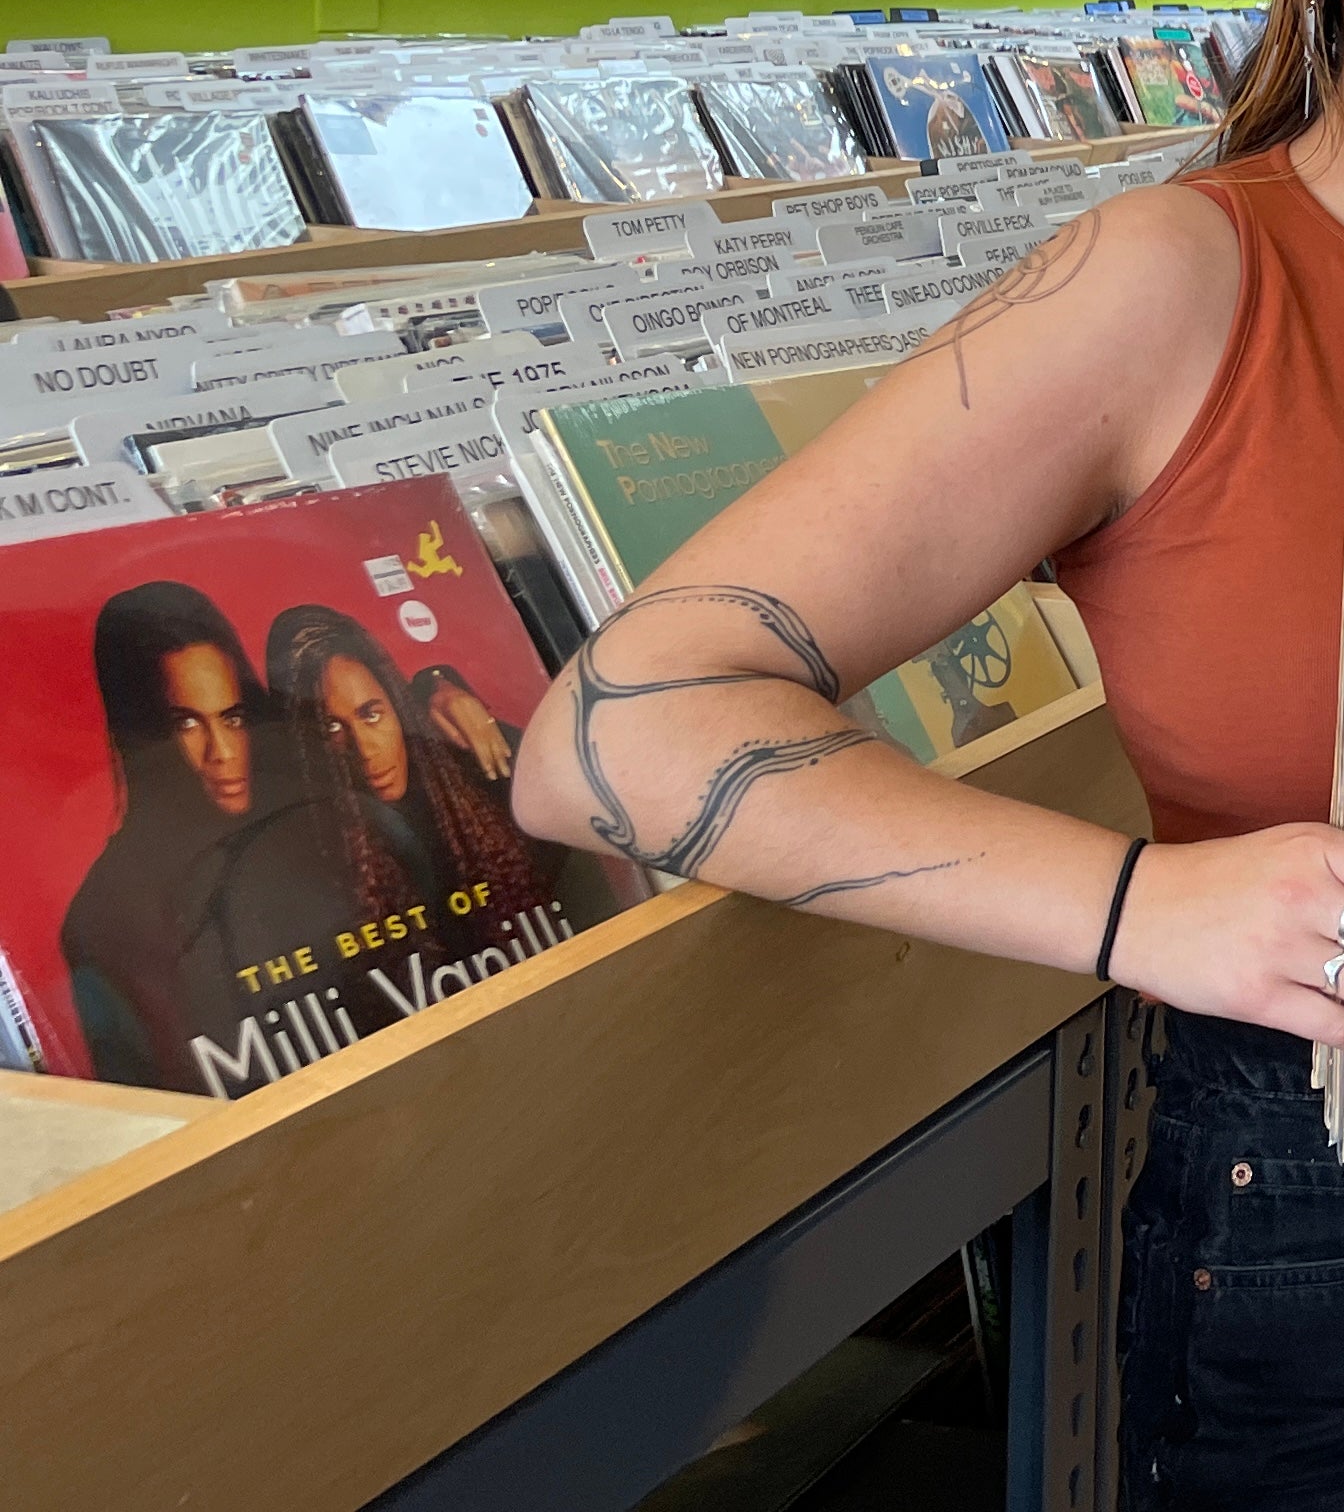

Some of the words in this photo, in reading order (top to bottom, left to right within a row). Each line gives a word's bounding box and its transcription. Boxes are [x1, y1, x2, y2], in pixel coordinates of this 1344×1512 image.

[813, 197, 845, 217] SHOP
[846, 192, 879, 210] BOYS
[612, 221, 644, 239] TOM
[644, 213, 687, 233] PETTY
[714, 236, 748, 255] KATY
[751, 230, 795, 251] PERRY
[956, 216, 1003, 238] ORVILLE
[1004, 214, 1035, 231] PECK
[715, 254, 780, 281] ORBISON
[890, 281, 941, 309] SINEAD
[632, 306, 686, 333] OINGO
[727, 313, 749, 335] OF
[751, 295, 833, 330] MONTREAL
[731, 352, 767, 371] NEW
[769, 334, 894, 367] PORNOGRAPHERS
[33, 369, 75, 394] NO
[76, 358, 160, 389] DOUBT
[374, 445, 460, 483] STEVIE
[596, 439, 651, 470] The
[650, 432, 712, 461] New
[14, 490, 44, 518] M
[45, 479, 133, 514] CONT.
[236, 945, 319, 995] THE
[335, 904, 427, 960] BEST
[448, 881, 492, 915] OF
[188, 987, 361, 1100] Milli
[367, 900, 575, 1017] Vanilli
